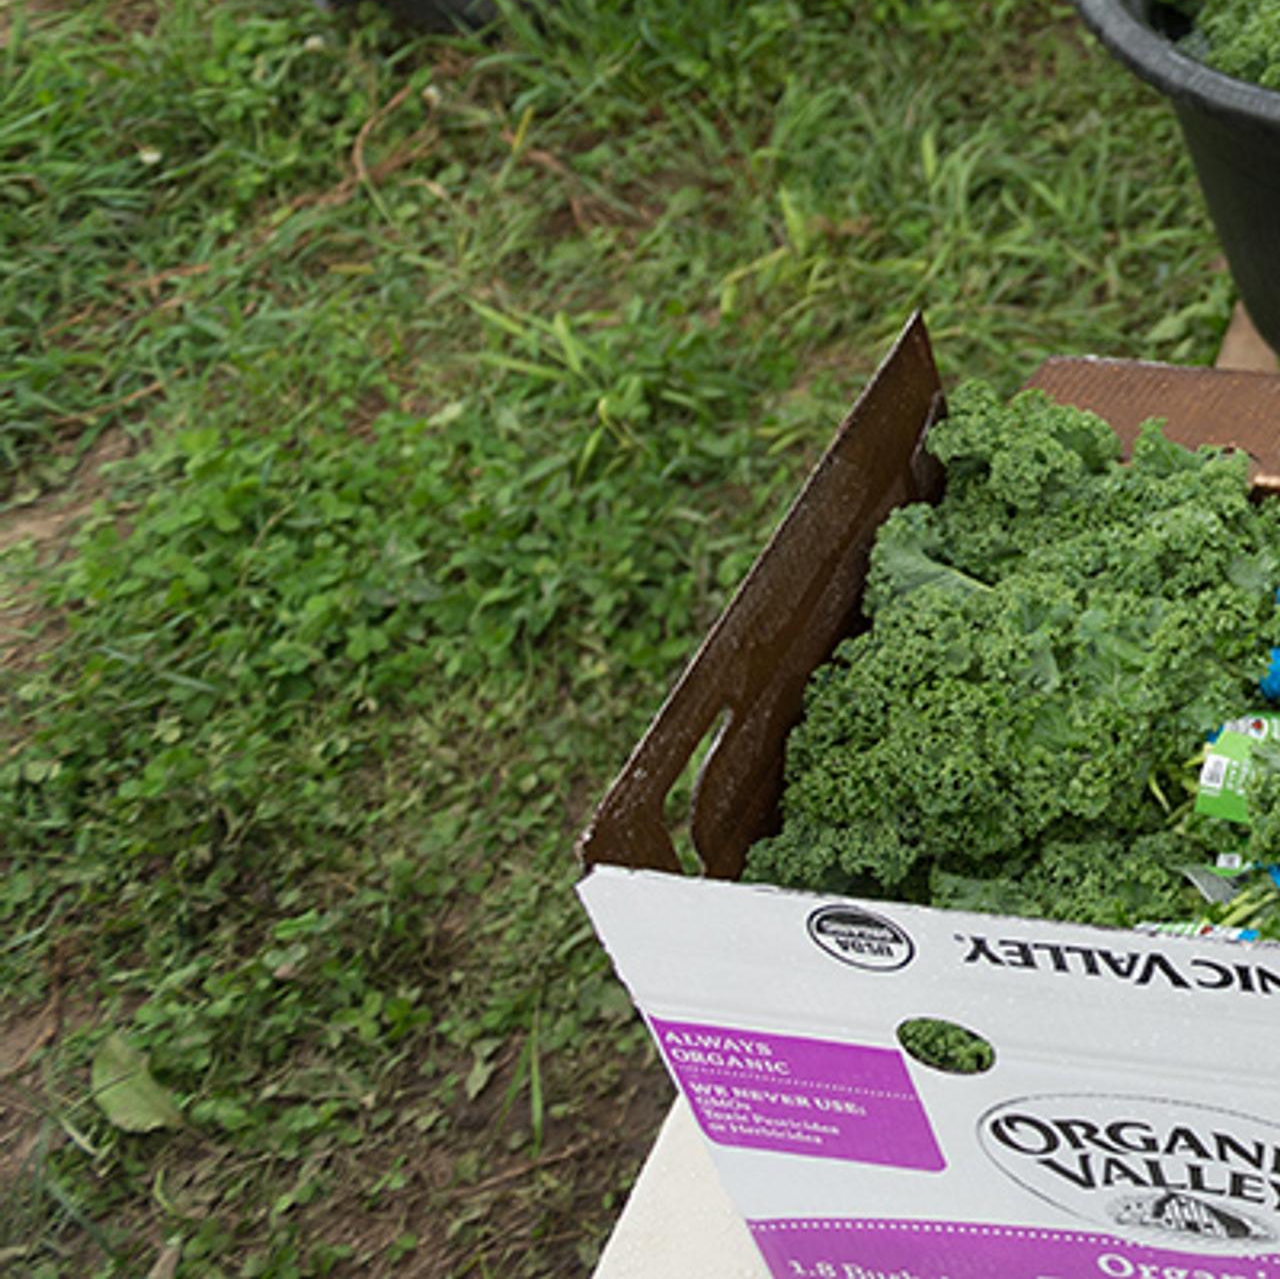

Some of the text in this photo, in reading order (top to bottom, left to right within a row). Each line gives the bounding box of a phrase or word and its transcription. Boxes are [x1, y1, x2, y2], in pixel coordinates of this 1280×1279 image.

[963, 935, 1192, 990] VALLEY
[664, 1031, 773, 1057] ALWAYS
[669, 1048, 791, 1076] ORGANIC
[688, 1080, 728, 1098] WE
[732, 1086, 812, 1109] NEVER
